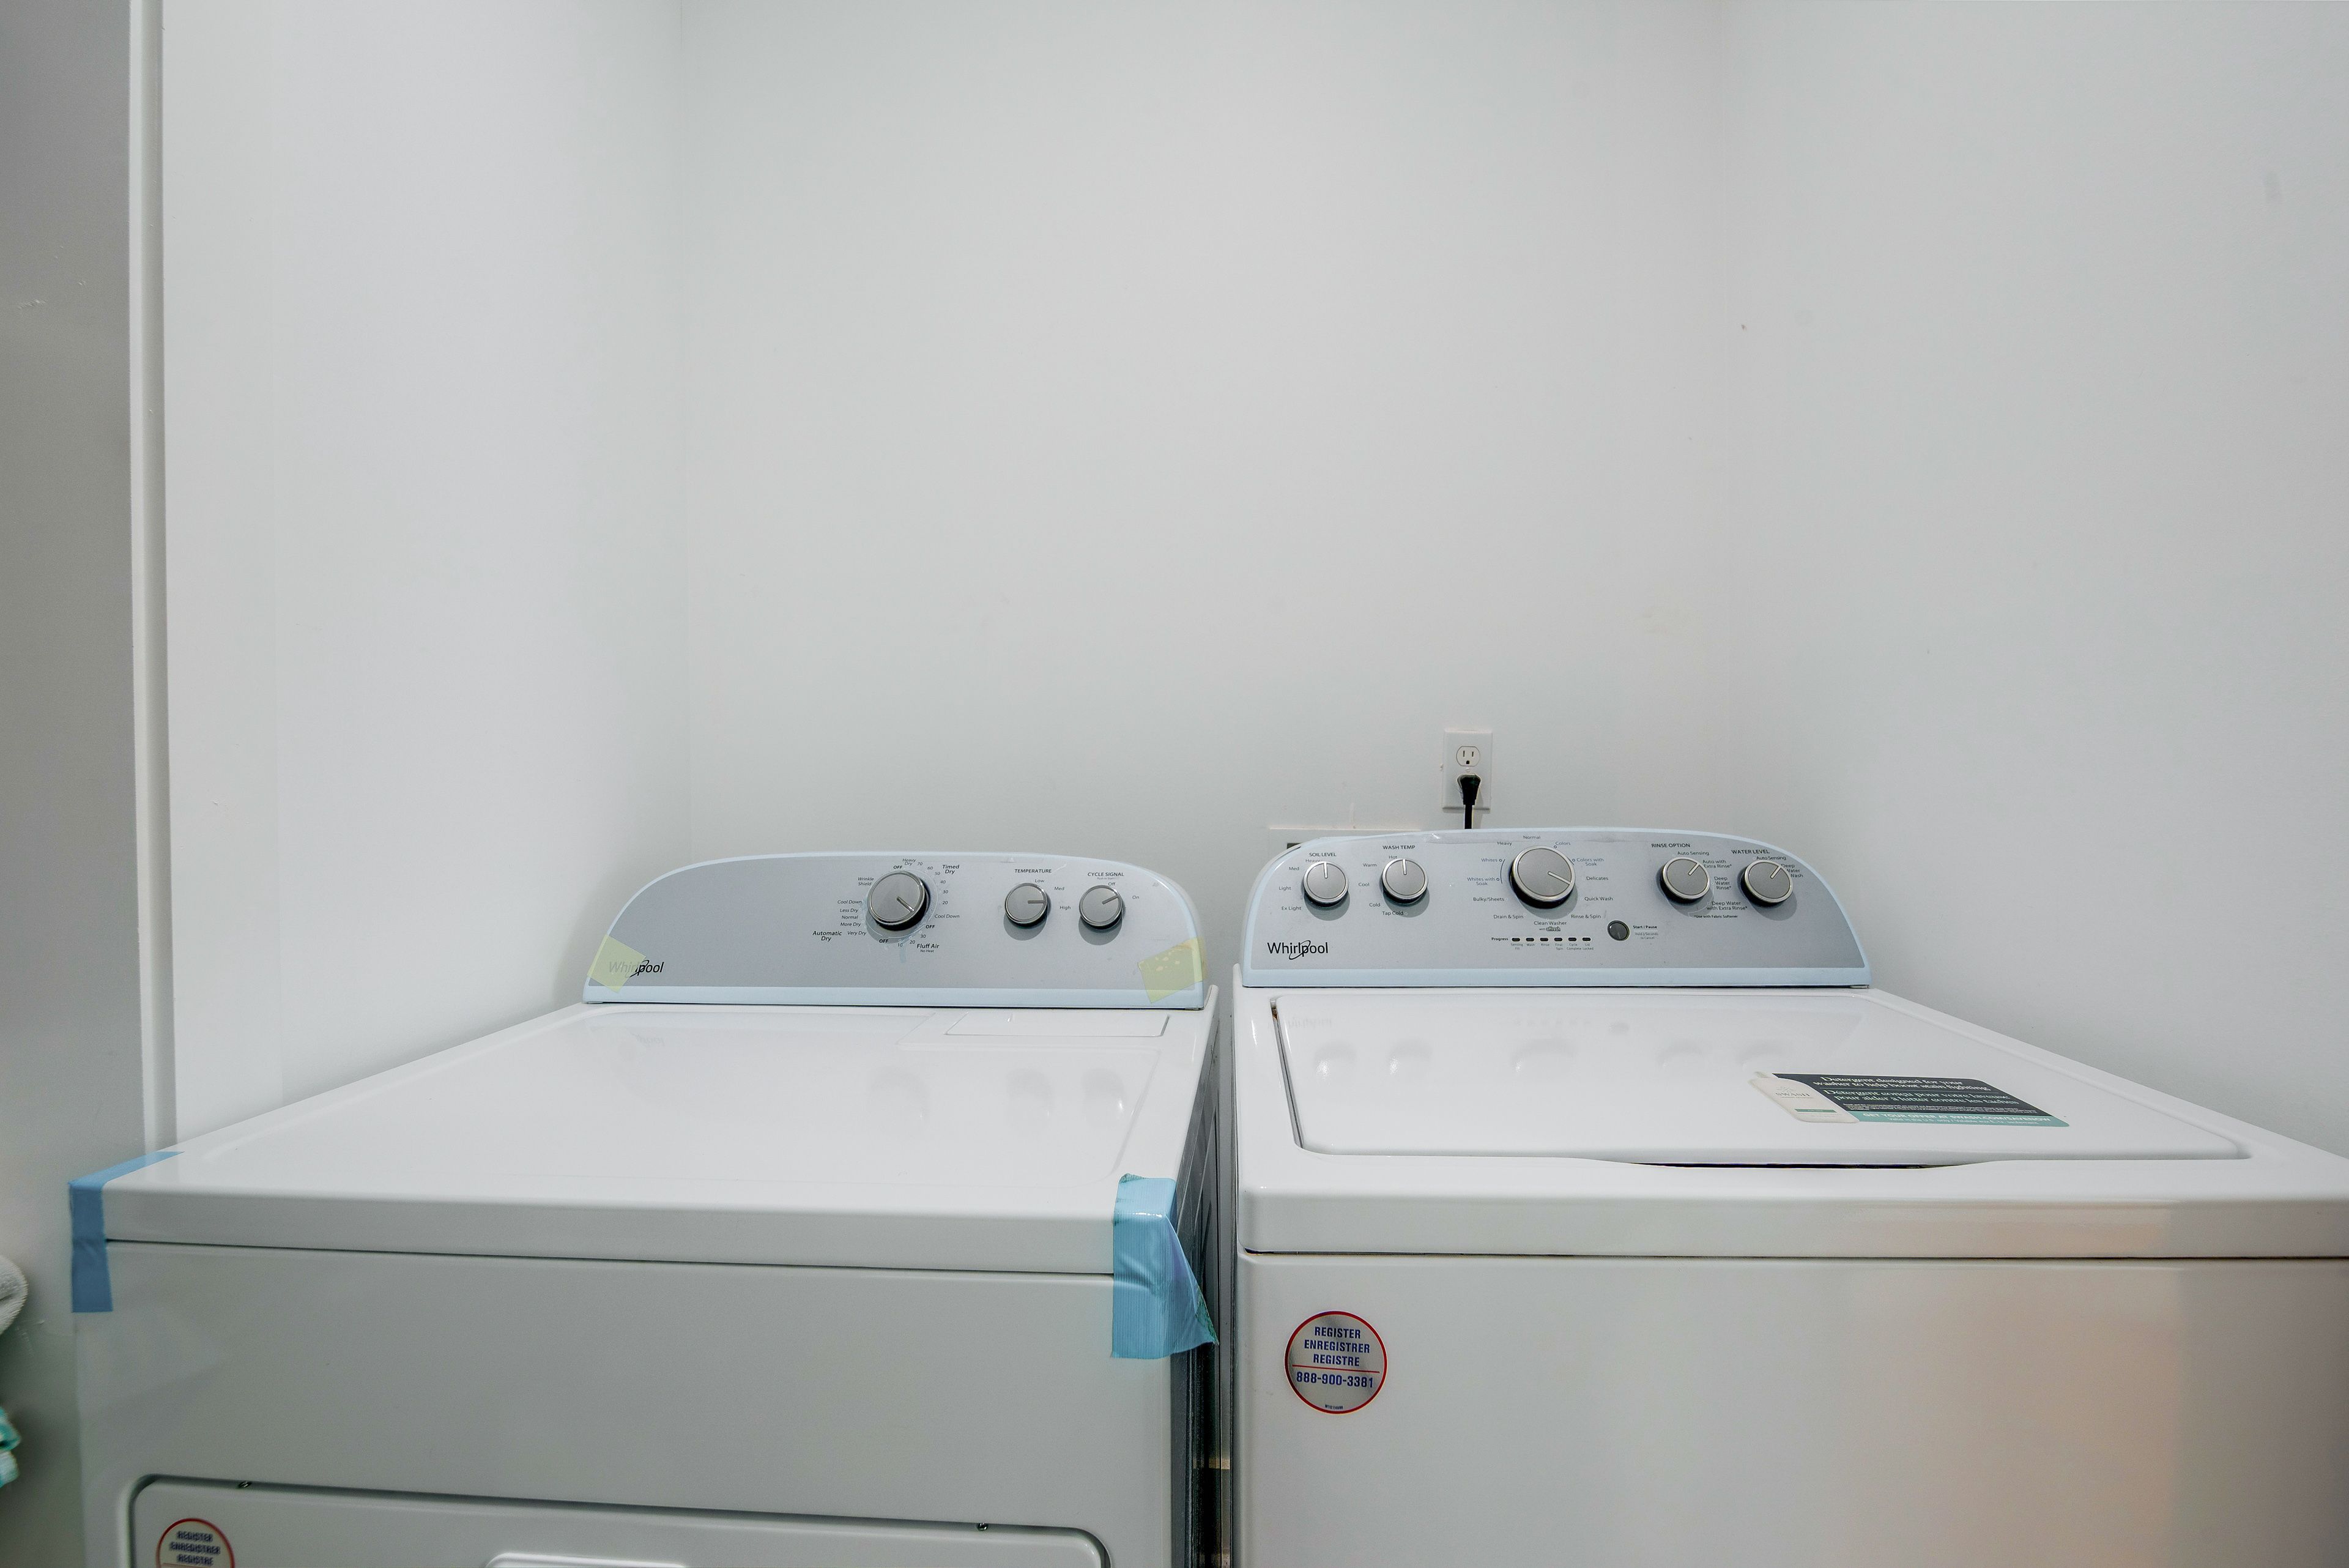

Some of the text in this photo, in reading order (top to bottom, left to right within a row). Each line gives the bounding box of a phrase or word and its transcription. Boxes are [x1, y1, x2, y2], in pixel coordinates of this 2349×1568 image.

[1267, 940, 1329, 960] Whirlpool
[1315, 1326, 1361, 1339] REGISTER
[1304, 1339, 1370, 1353] ENREGISTRER
[1313, 1354, 1360, 1366] REGISTRE
[1296, 1371, 1373, 1388] 888-900-3381
[177, 1531, 213, 1542] REGISTER
[170, 1542, 220, 1554] ENREGISTRER
[177, 1555, 213, 1566] REGISTRE
